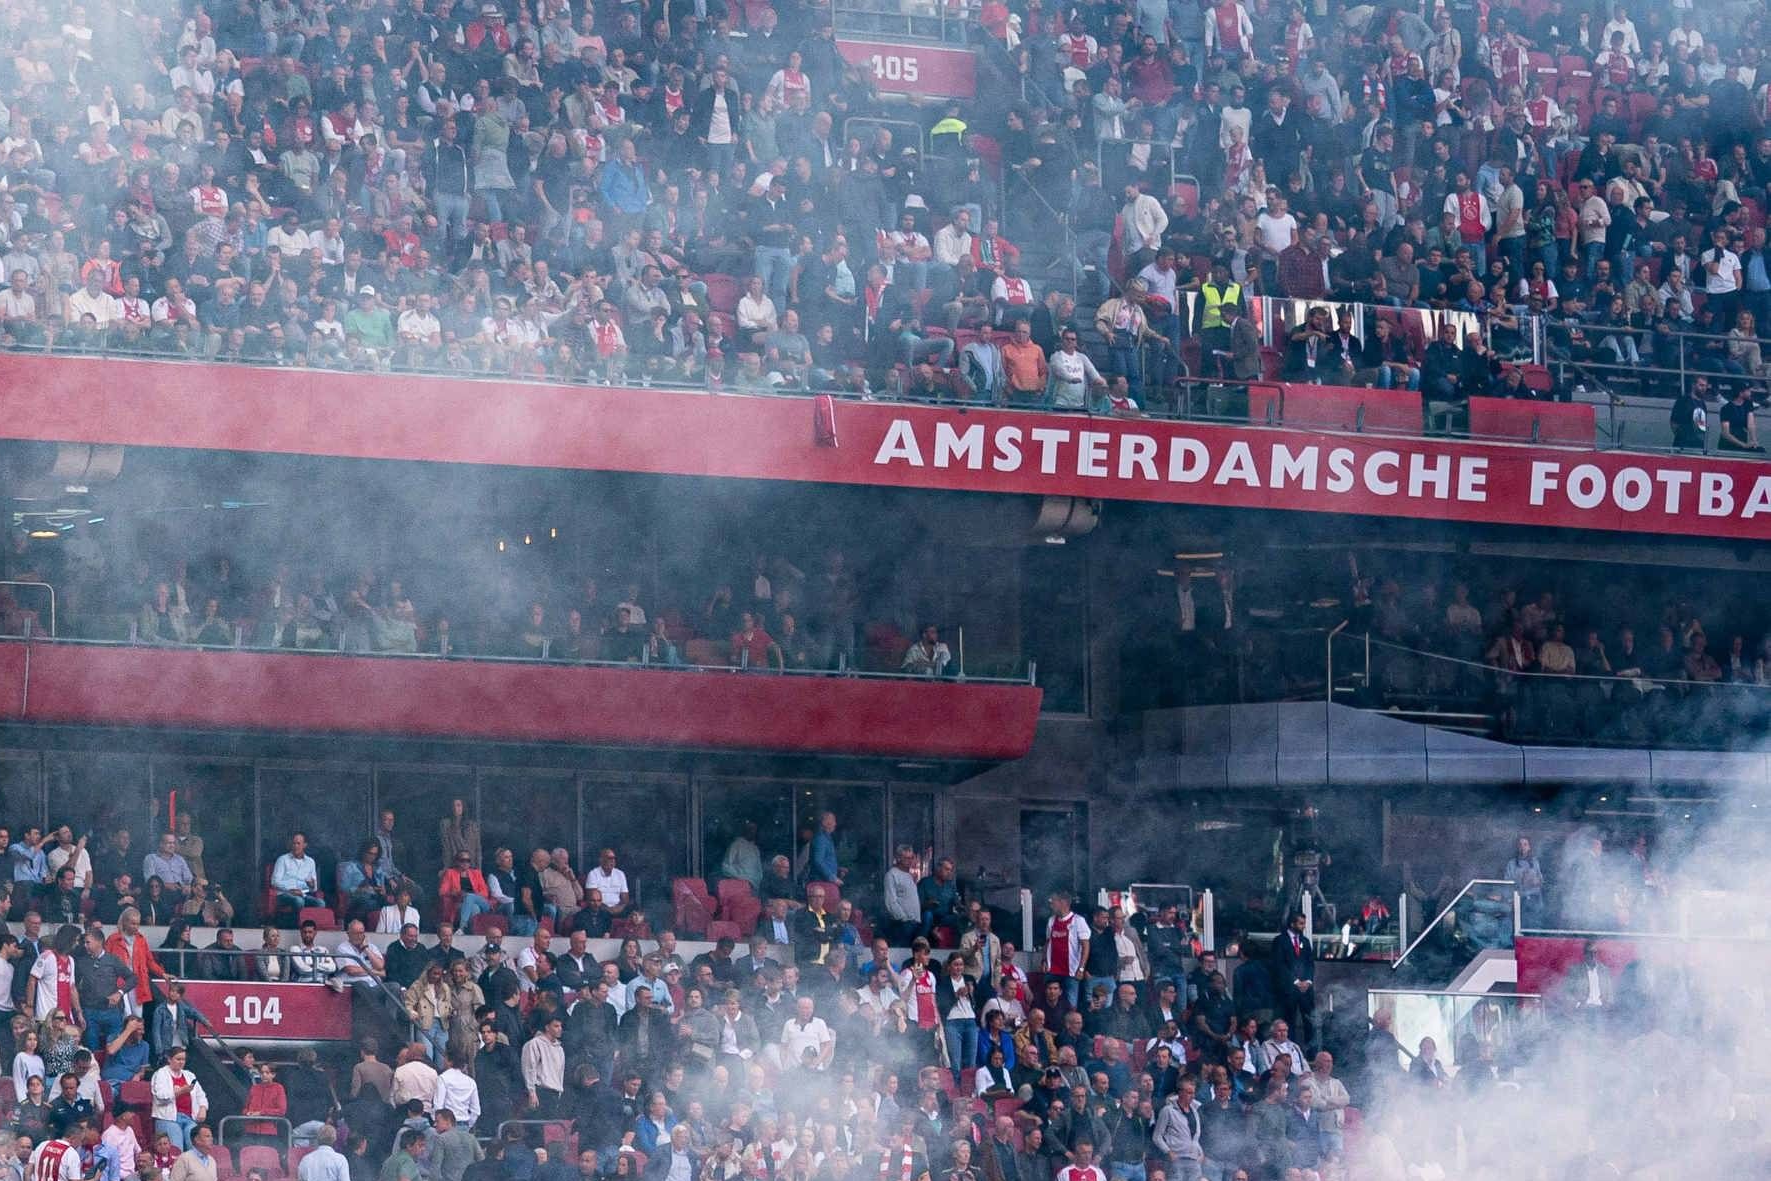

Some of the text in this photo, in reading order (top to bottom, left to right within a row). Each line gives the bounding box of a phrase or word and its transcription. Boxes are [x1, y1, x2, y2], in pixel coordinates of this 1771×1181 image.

[874, 419, 1771, 519] AMSTERDAMSCHE FOOTBA
[223, 995, 283, 1025] 104
